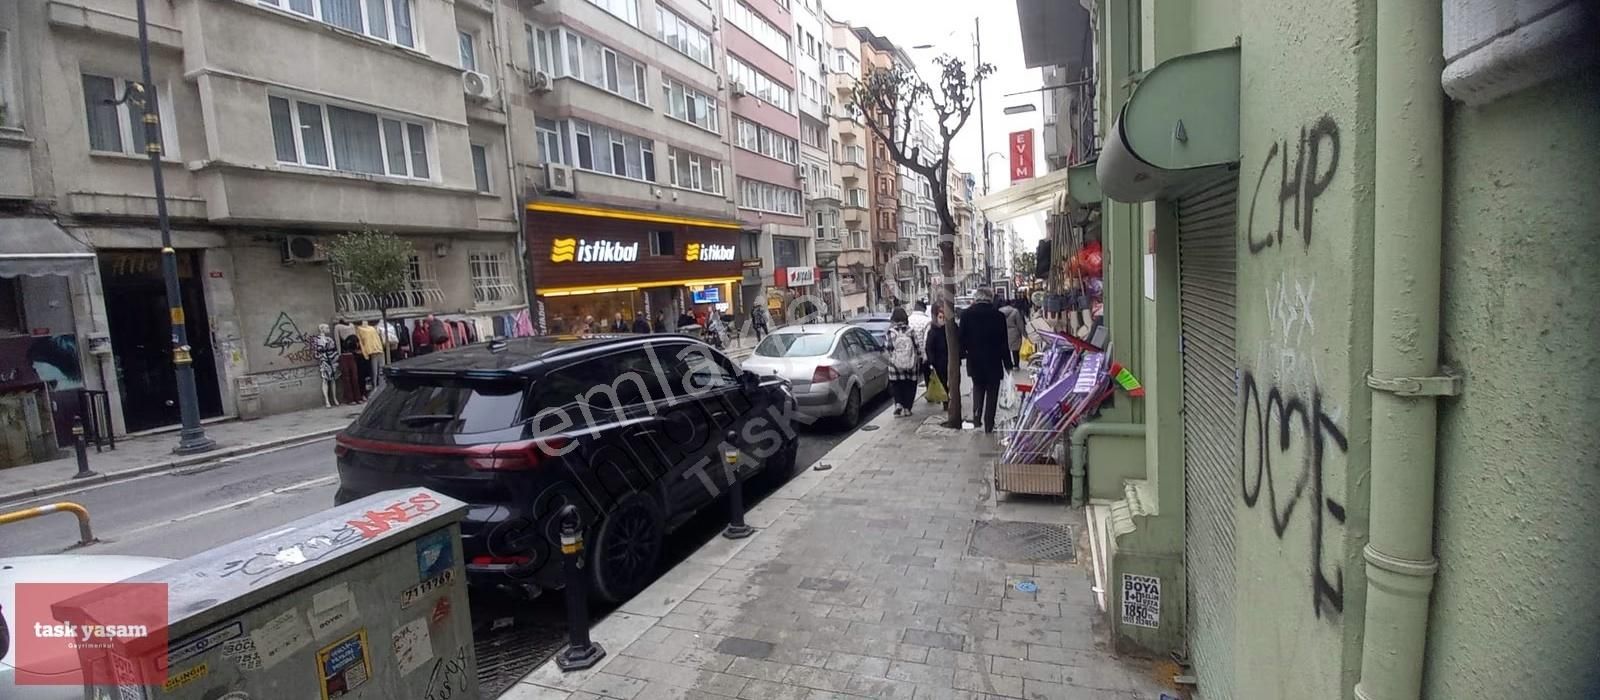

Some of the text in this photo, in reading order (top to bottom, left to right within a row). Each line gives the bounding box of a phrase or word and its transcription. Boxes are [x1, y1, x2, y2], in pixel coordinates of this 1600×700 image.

[1248, 113, 1341, 255] CHP
[577, 239, 639, 262] istikbal
[700, 243, 735, 261] istikbal
[1125, 581, 1159, 595] BOYA
[1124, 605, 1147, 619] 1850
